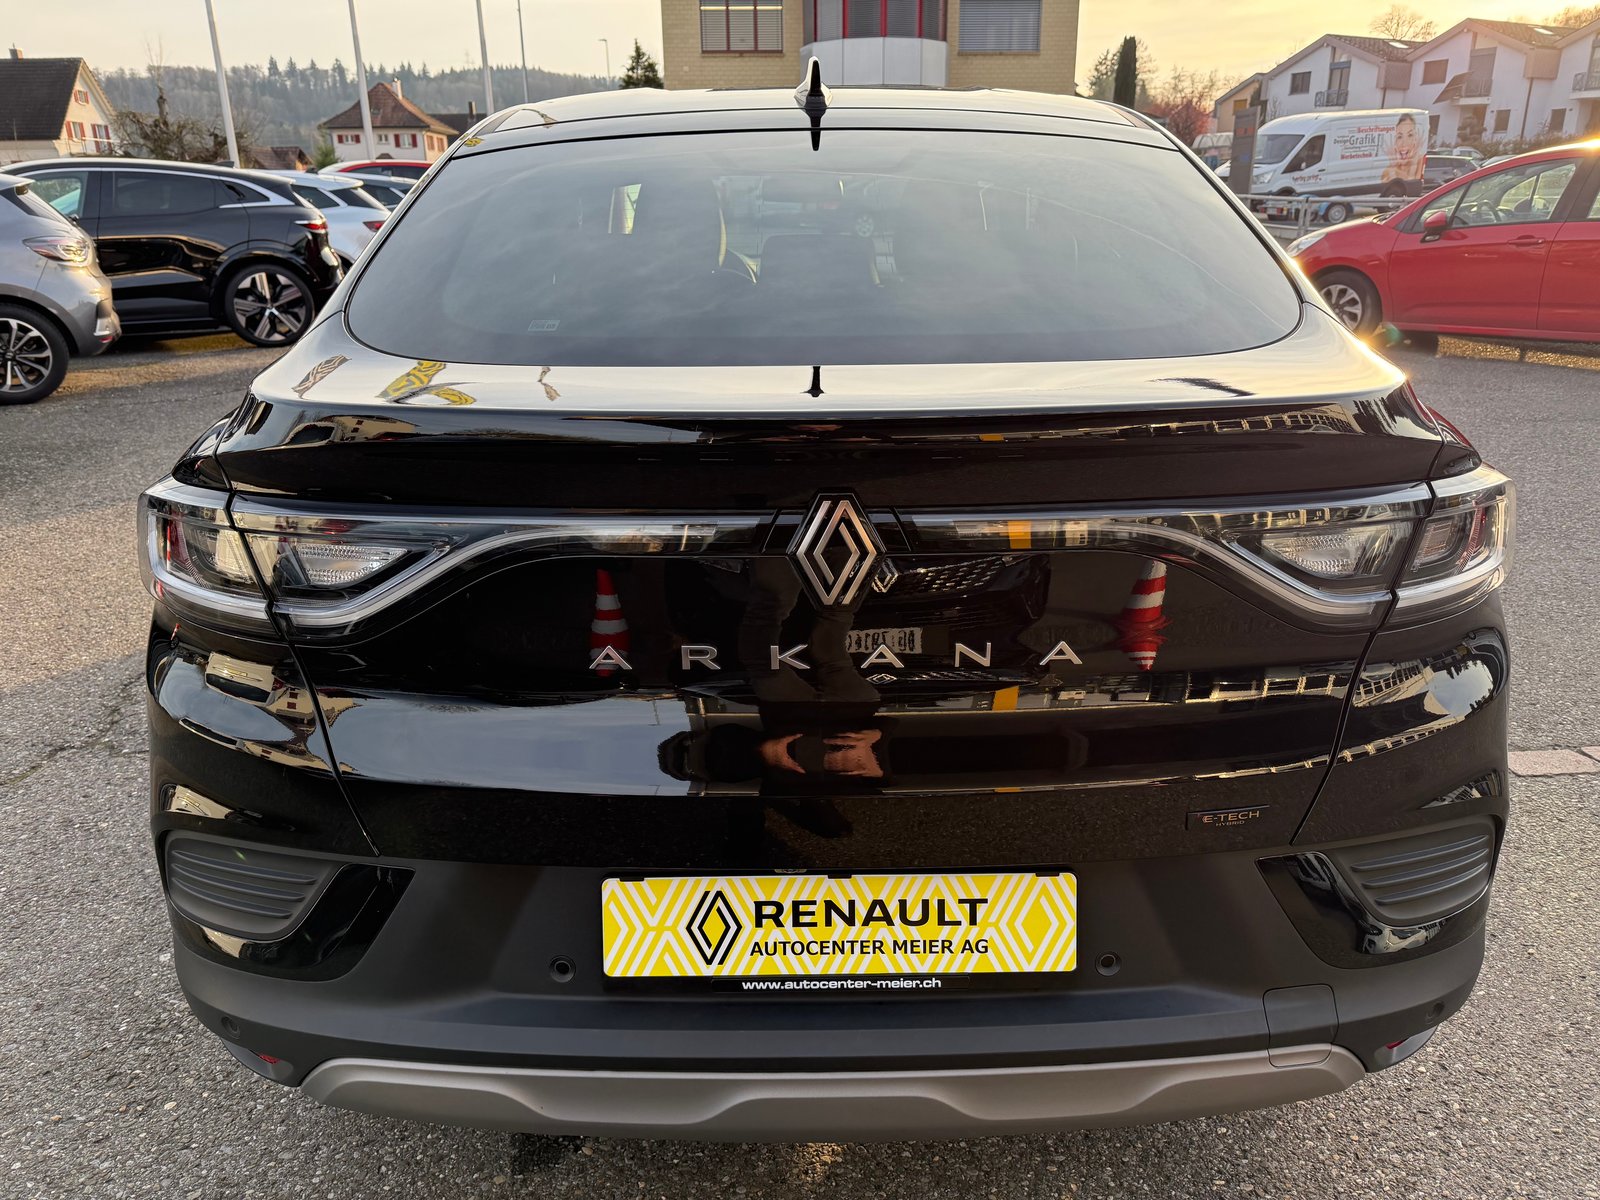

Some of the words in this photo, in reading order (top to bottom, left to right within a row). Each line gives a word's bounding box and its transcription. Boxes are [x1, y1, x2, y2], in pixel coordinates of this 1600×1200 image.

[1349, 134, 1376, 145] Grafik
[589, 641, 1083, 670] ARKANA
[1202, 810, 1260, 823] E-TECH
[753, 898, 989, 928] RENAULT
[749, 940, 885, 957] AUTOCENTER
[892, 939, 954, 955] MEIER
[960, 938, 989, 955] AG
[742, 977, 942, 991] www.autocenter-meier.ch
